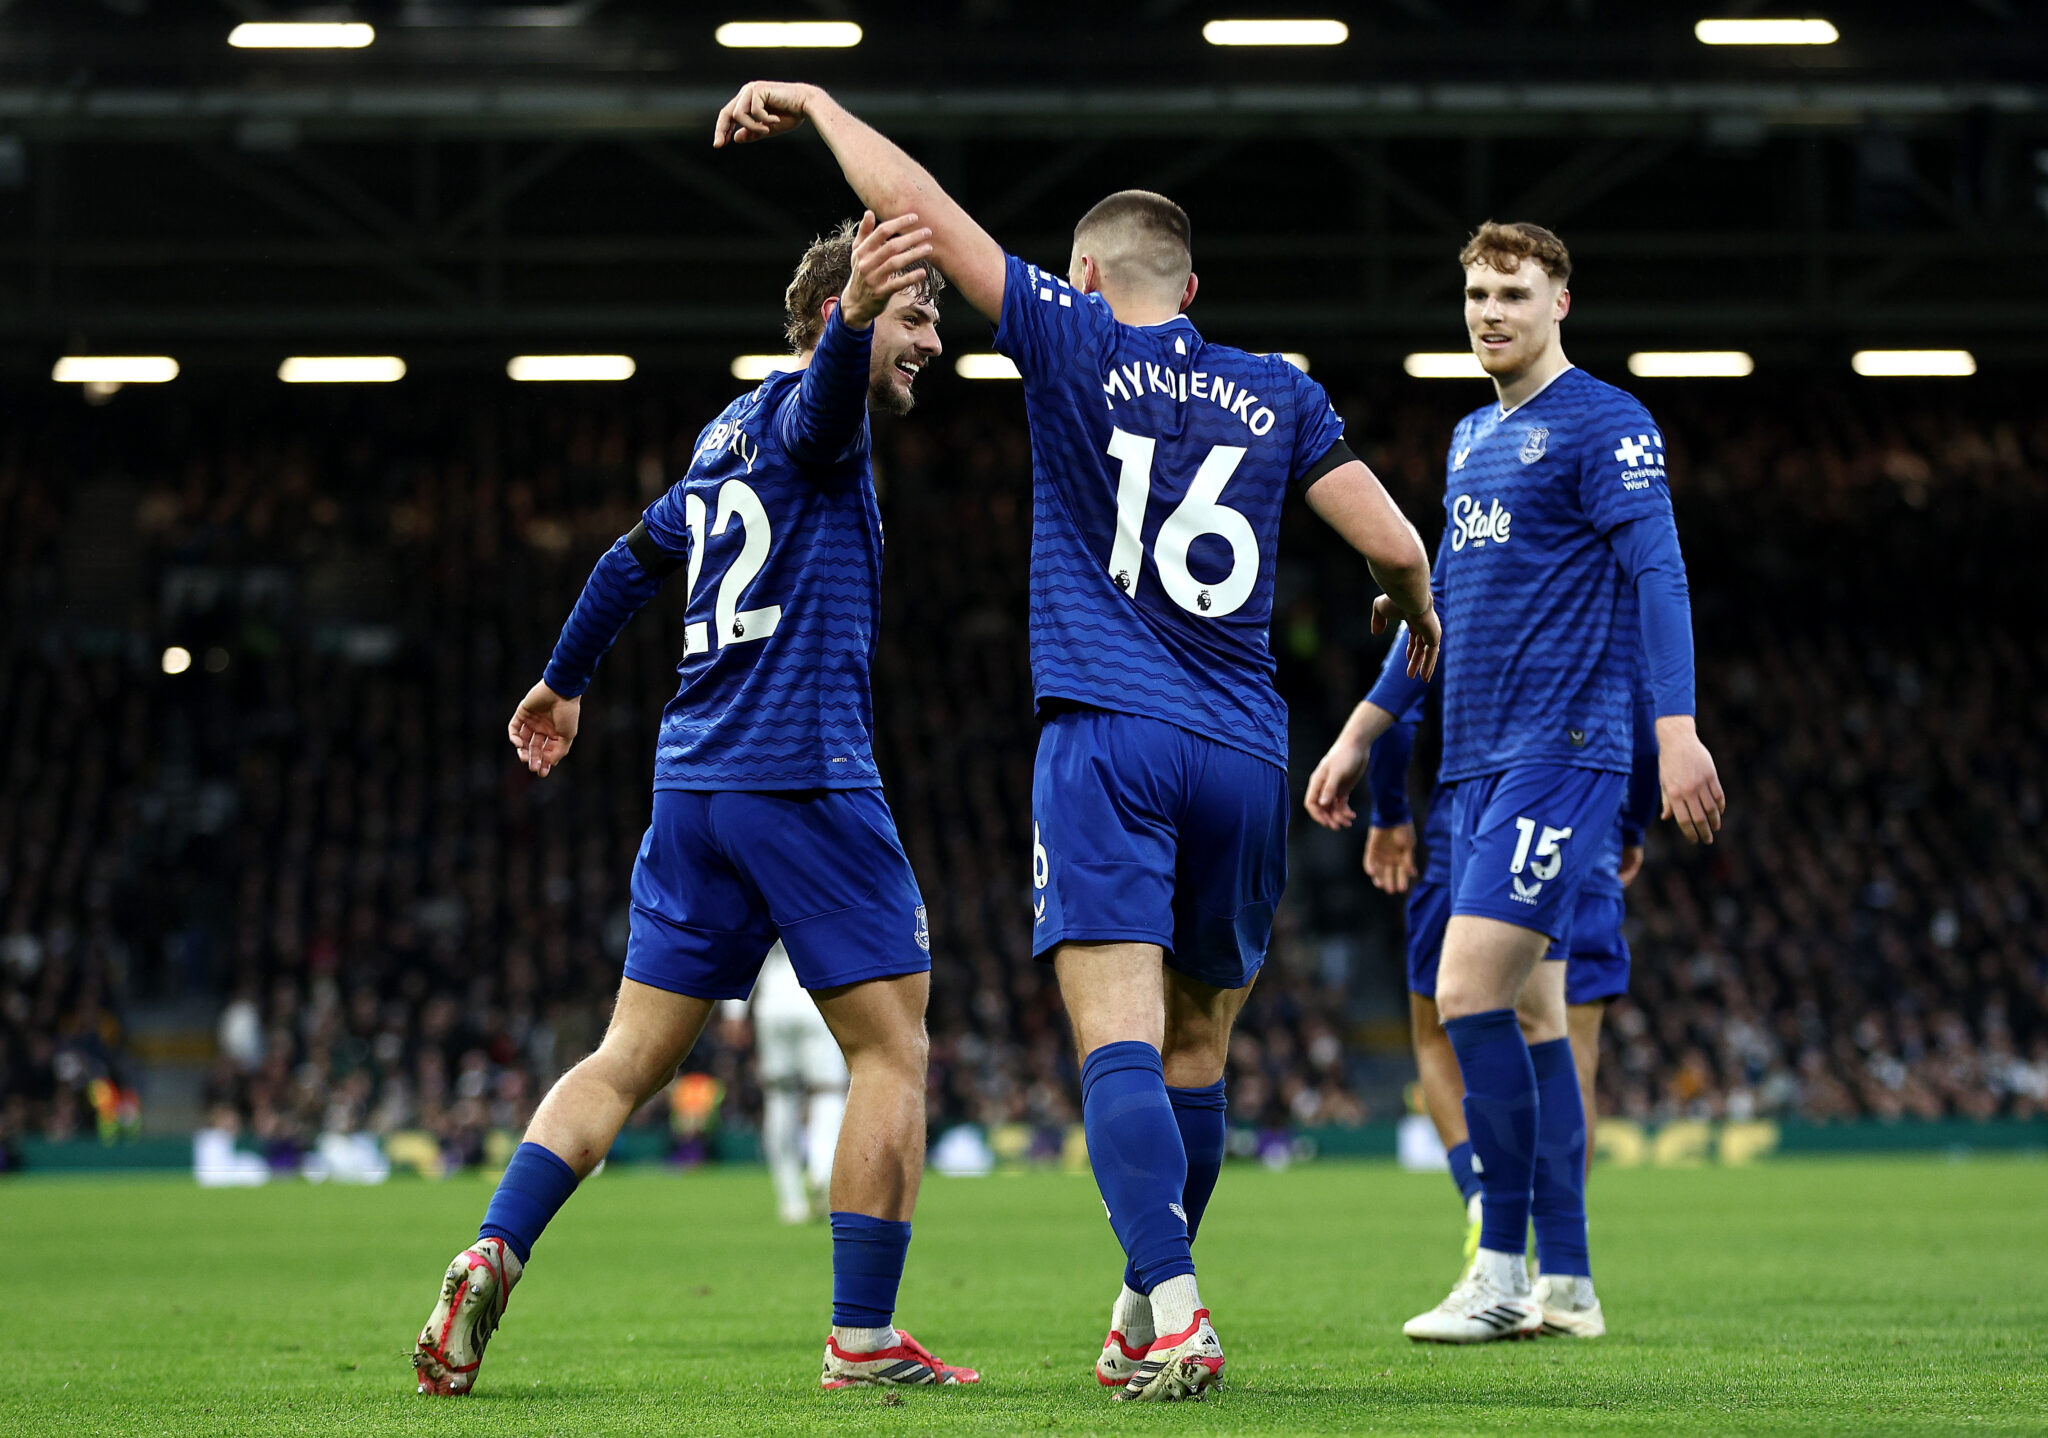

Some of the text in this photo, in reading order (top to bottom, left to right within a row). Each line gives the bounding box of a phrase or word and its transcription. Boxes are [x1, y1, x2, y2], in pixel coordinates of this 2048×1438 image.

[1103, 361, 1276, 437] MYKOLENKO
[1622, 477, 1650, 491] Ward
[1106, 425, 1261, 618] 16
[1451, 493, 1512, 552] Stake
[1033, 820, 1049, 889] 6
[1509, 816, 1573, 881] 15
